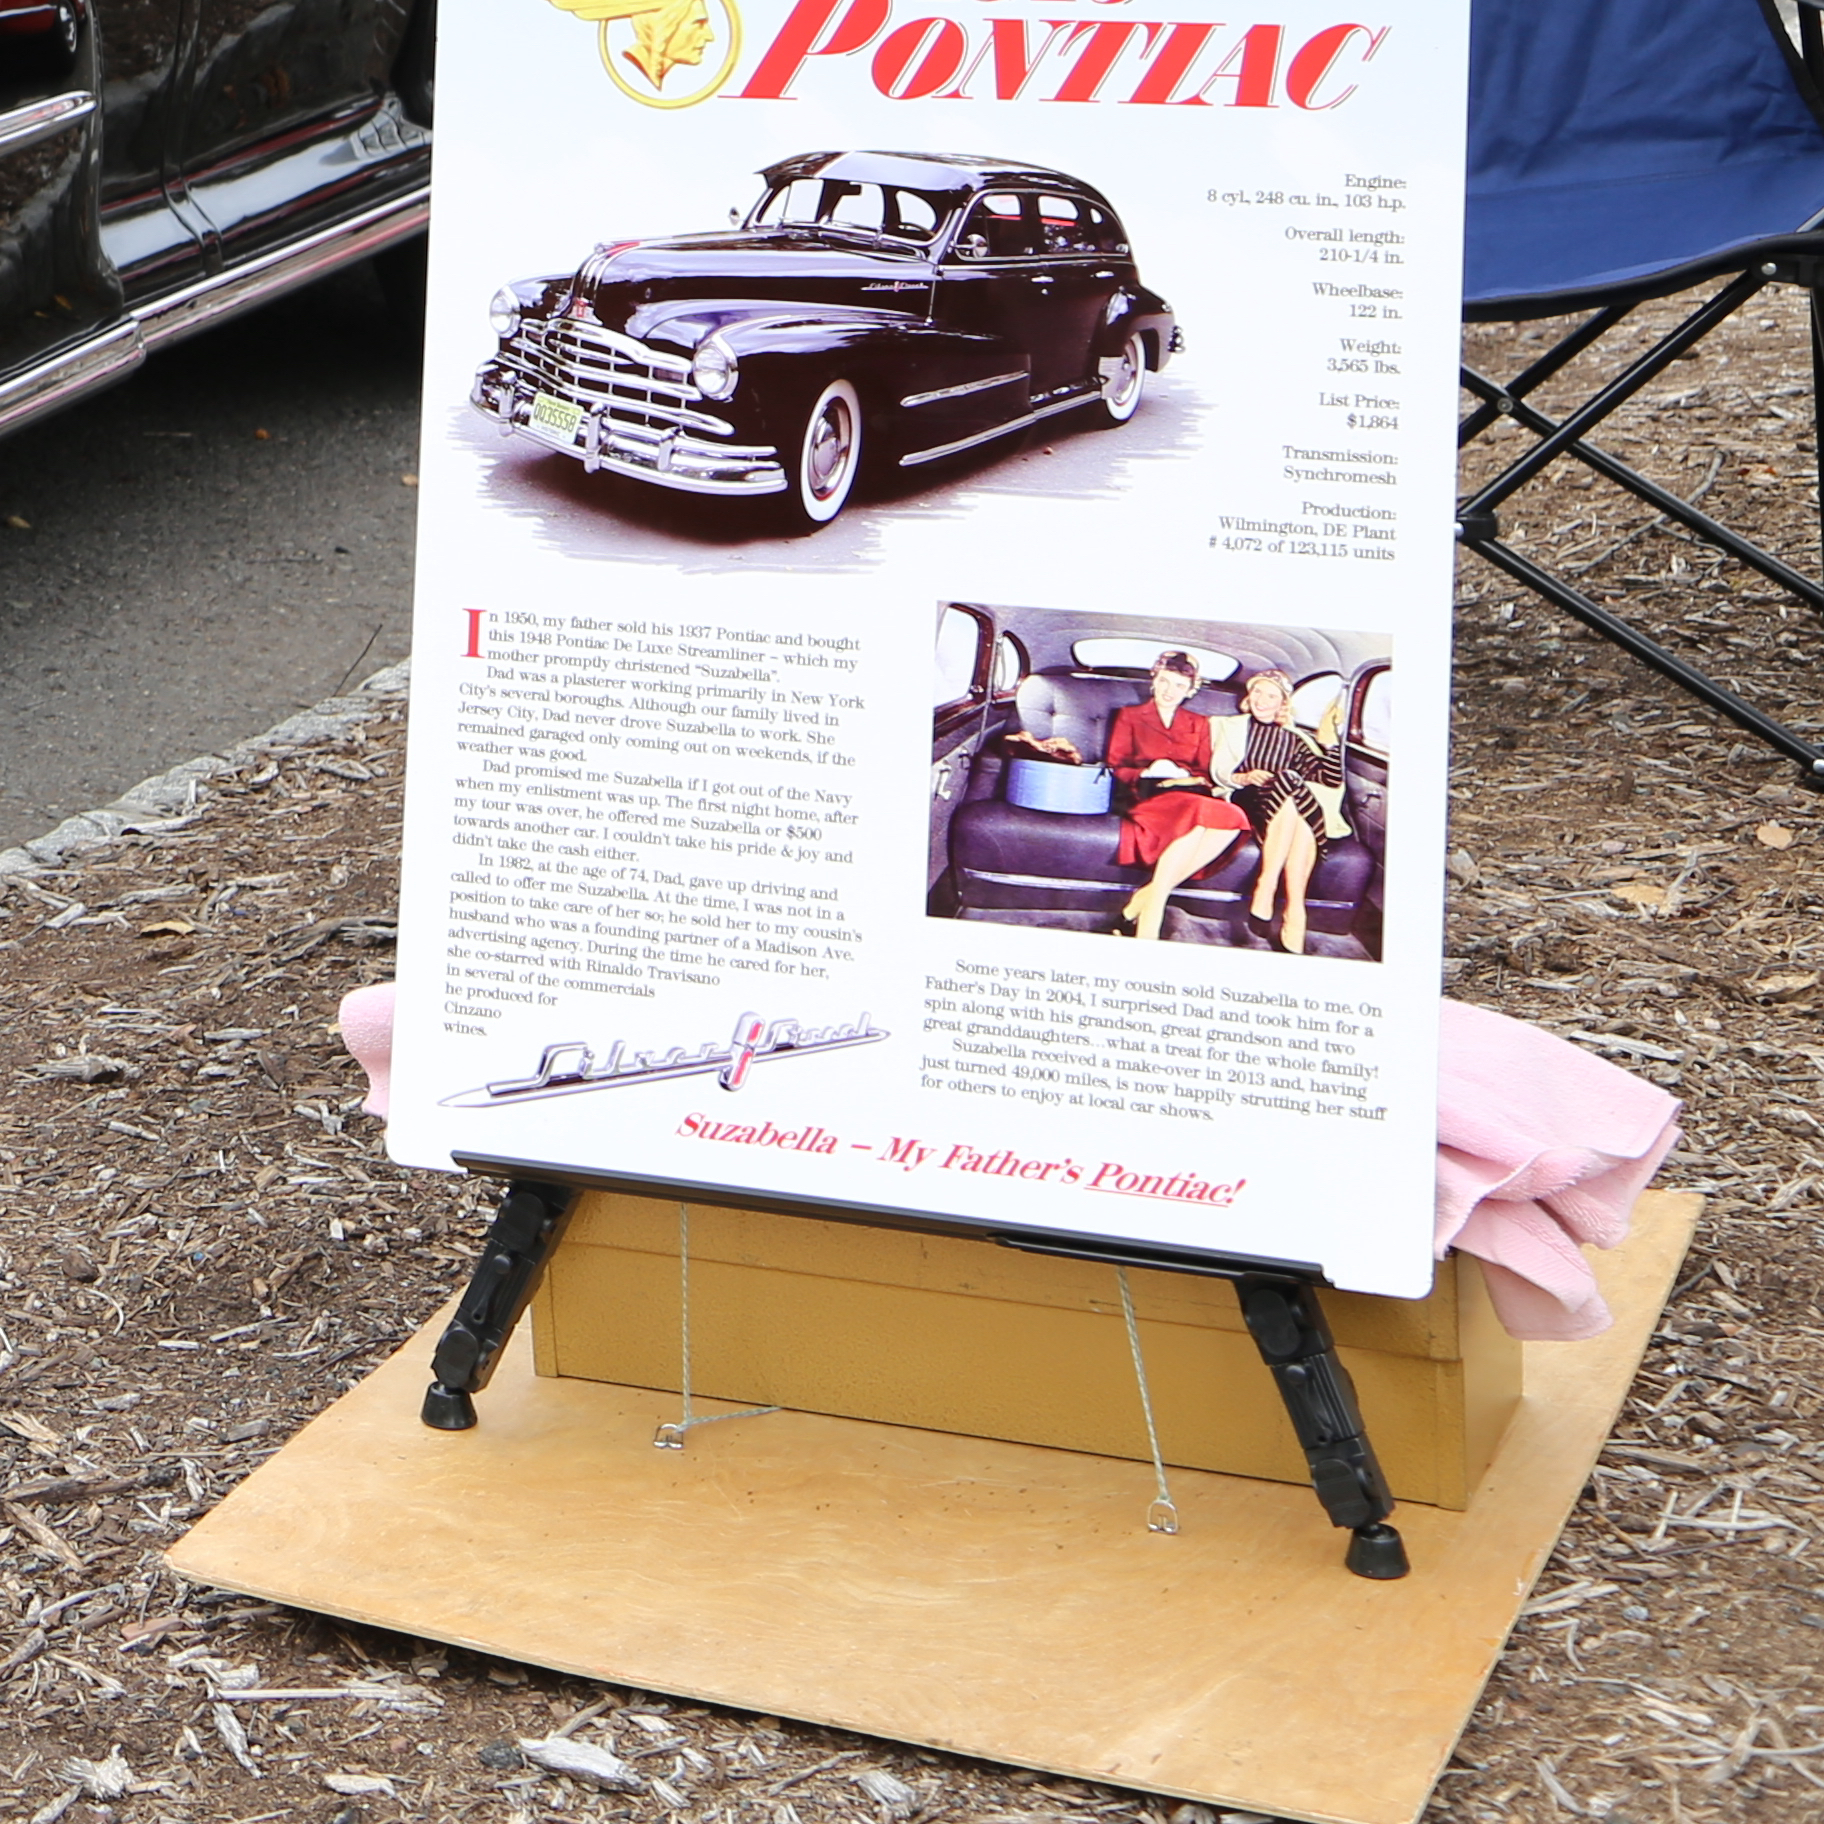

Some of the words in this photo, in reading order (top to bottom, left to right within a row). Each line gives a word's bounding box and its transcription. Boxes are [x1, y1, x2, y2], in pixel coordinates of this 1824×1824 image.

[1344, 172, 1406, 192] Engine:
[1206, 188, 1217, 202] 8
[1220, 189, 1251, 207] cyl.,
[1255, 189, 1284, 205] 248
[1287, 194, 1311, 206] cu.
[1315, 192, 1339, 208] in.,
[1345, 193, 1372, 208] 103
[1376, 194, 1406, 213] h.p.
[1284, 226, 1343, 242] Overall
[1348, 228, 1405, 247] length:
[1318, 247, 1379, 263] 210-1/4
[1383, 250, 1404, 264] in.
[1311, 281, 1403, 299] Wheelbase:
[1349, 303, 1377, 319] 122
[1382, 304, 1403, 319] in.
[1339, 337, 1401, 356] Weight:
[1326, 356, 1369, 373] 3,565
[1373, 358, 1401, 374] lbs.
[1319, 391, 1349, 407] List
[1354, 393, 1400, 409] Price:
[1346, 412, 1398, 430] $1,864
[1281, 444, 1398, 465] Transmission:
[1283, 465, 1396, 485] Synchromesh
[1301, 500, 1396, 521] Production:
[1218, 515, 1318, 537] Wilmington,
[1322, 521, 1347, 537] DE
[1352, 523, 1396, 541] Plant
[1221, 536, 1262, 552] 4,072
[1266, 538, 1285, 553] of
[1289, 540, 1348, 557] 123,115
[1352, 546, 1395, 561] units
[504, 610, 539, 626] 1950,
[542, 616, 564, 631] my
[569, 615, 613, 631] father
[616, 620, 647, 634] sold
[651, 621, 673, 636] his
[679, 624, 712, 639] 1937
[716, 626, 771, 643] Pontiac
[774, 633, 803, 646] and
[806, 633, 859, 652] bought
[487, 628, 515, 642] this
[520, 630, 552, 645] 1948
[556, 632, 609, 650] Pontiac
[613, 637, 632, 651] De
[636, 639, 673, 655] Luxe
[676, 643, 766, 662] Streamliner
[782, 652, 829, 667] which
[833, 657, 858, 673] my
[487, 648, 540, 663] mother
[543, 654, 608, 672] promptly
[613, 657, 690, 676] christened
[482, 758, 510, 774] Dad
[514, 764, 582, 781] promised
[586, 770, 609, 782] me
[612, 771, 683, 790] Suzabella
[687, 777, 700, 791] if
[711, 782, 734, 795] got
[738, 785, 763, 797] out
[766, 785, 784, 799] of
[785, 786, 810, 801] the
[814, 788, 850, 808] Navy
[446, 943, 471, 958] she
[474, 950, 544, 967] co-starred
[548, 955, 581, 971] with
[585, 957, 643, 976] Rinaldo
[646, 964, 720, 985] Travisano
[955, 959, 999, 976] Some
[1003, 966, 1046, 981] years
[1050, 969, 1089, 987] later,
[1093, 976, 1119, 992] my
[1124, 980, 1176, 996] cousin
[1181, 984, 1214, 1000] sold
[1220, 988, 1298, 1009] Suzabella
[1303, 997, 1319, 1010] to
[1323, 1000, 1353, 1014] me.
[1358, 1002, 1382, 1018] On
[952, 1038, 1026, 1059] Suzabella
[1031, 1049, 1097, 1067] received
[1100, 1057, 1111, 1068] a
[1115, 1058, 1201, 1078] make-over
[1205, 1066, 1222, 1082] in
[1226, 1068, 1265, 1086] 2013
[1269, 1076, 1305, 1092] and,
[1309, 1078, 1367, 1101] having
[918, 1054, 949, 1071] just
[954, 1059, 1006, 1077] turned
[1011, 1064, 1060, 1082] 49,000
[1064, 1072, 1111, 1090] miles,
[1115, 1076, 1129, 1090] is
[1133, 1081, 1168, 1094] now
[1173, 1083, 1232, 1106] happily
[1240, 1093, 1311, 1114] strutting
[1315, 1099, 1345, 1115] her
[1348, 1105, 1388, 1121] stuff
[675, 1111, 840, 1156] Suzabella
[876, 1134, 937, 1173] My
[938, 1142, 1084, 1186] Father's
[1083, 1160, 1248, 1207] Pontiac!
